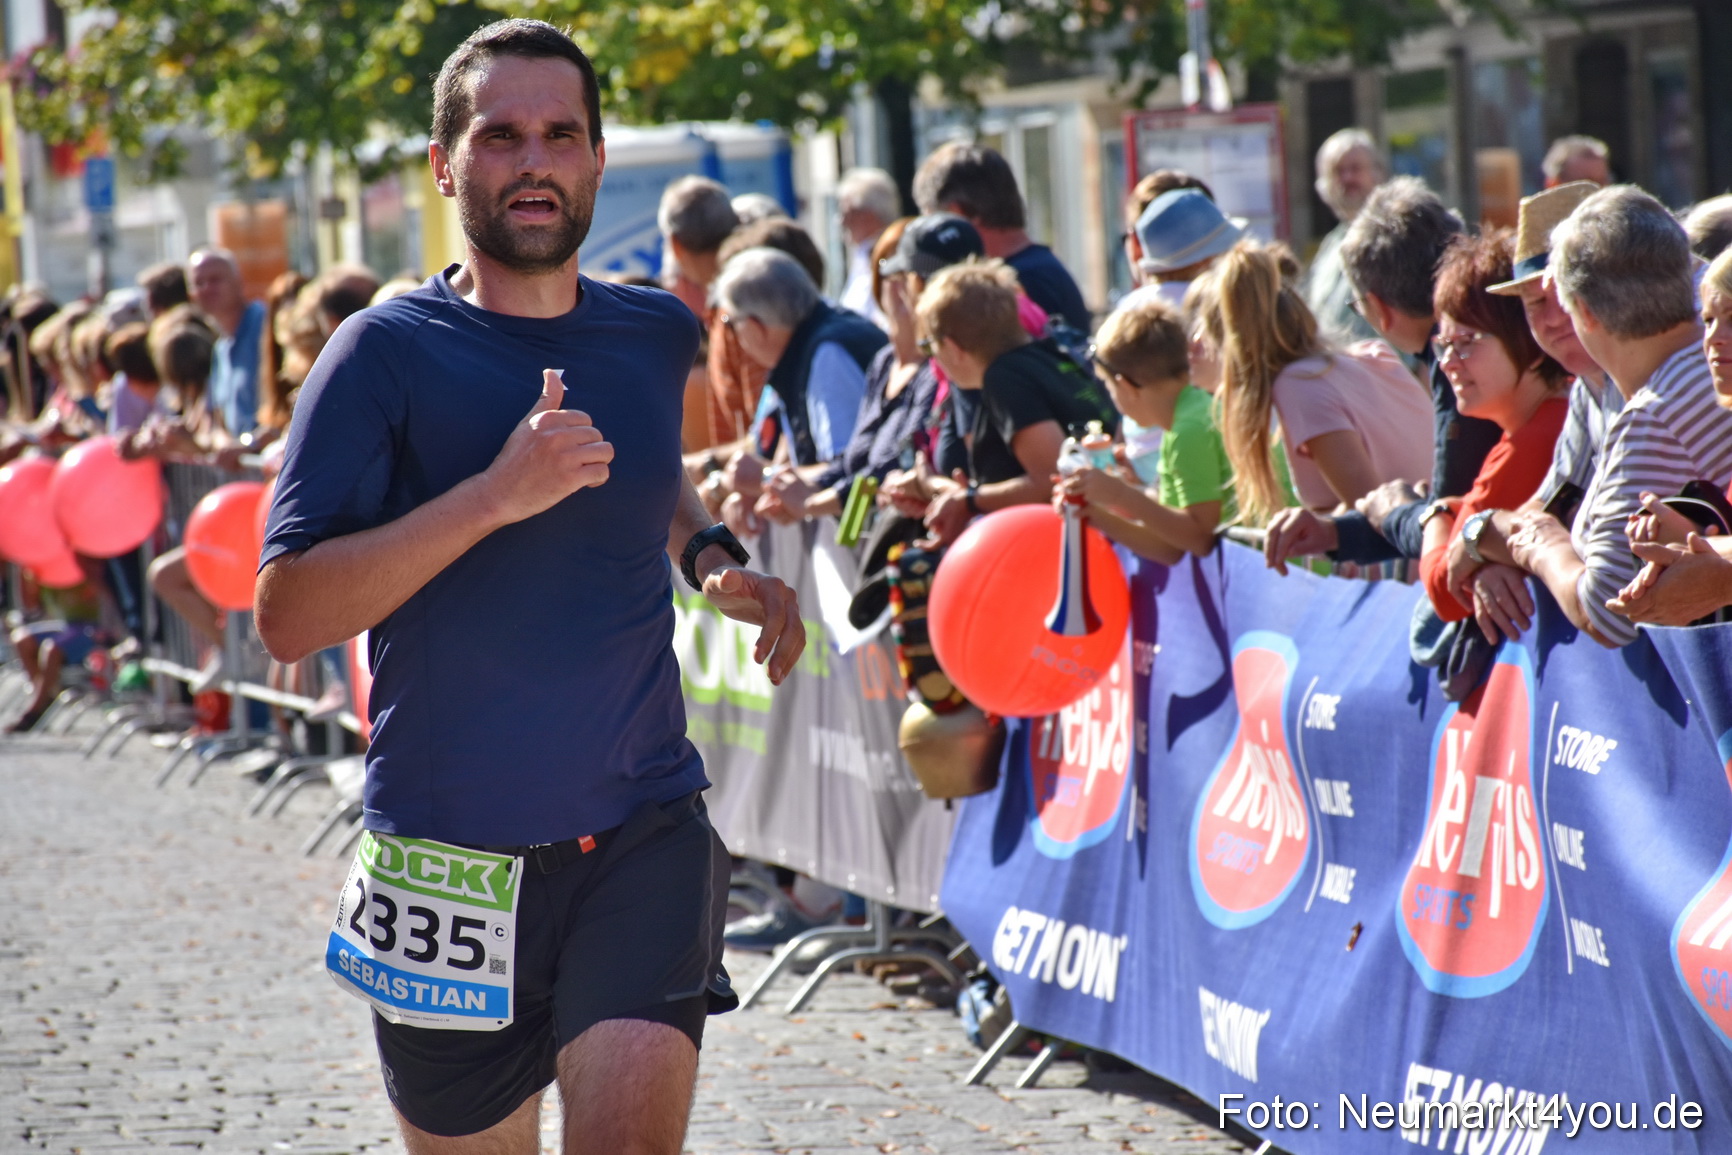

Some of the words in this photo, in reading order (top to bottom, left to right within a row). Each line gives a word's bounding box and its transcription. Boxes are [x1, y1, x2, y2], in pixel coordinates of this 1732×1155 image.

[1554, 724, 1618, 776] STORE
[349, 877, 487, 971] 2335
[494, 926, 505, 938] C
[992, 906, 1048, 975] GET
[338, 948, 487, 1011] SEBASTIAN
[1701, 966, 1732, 1012] SPO
